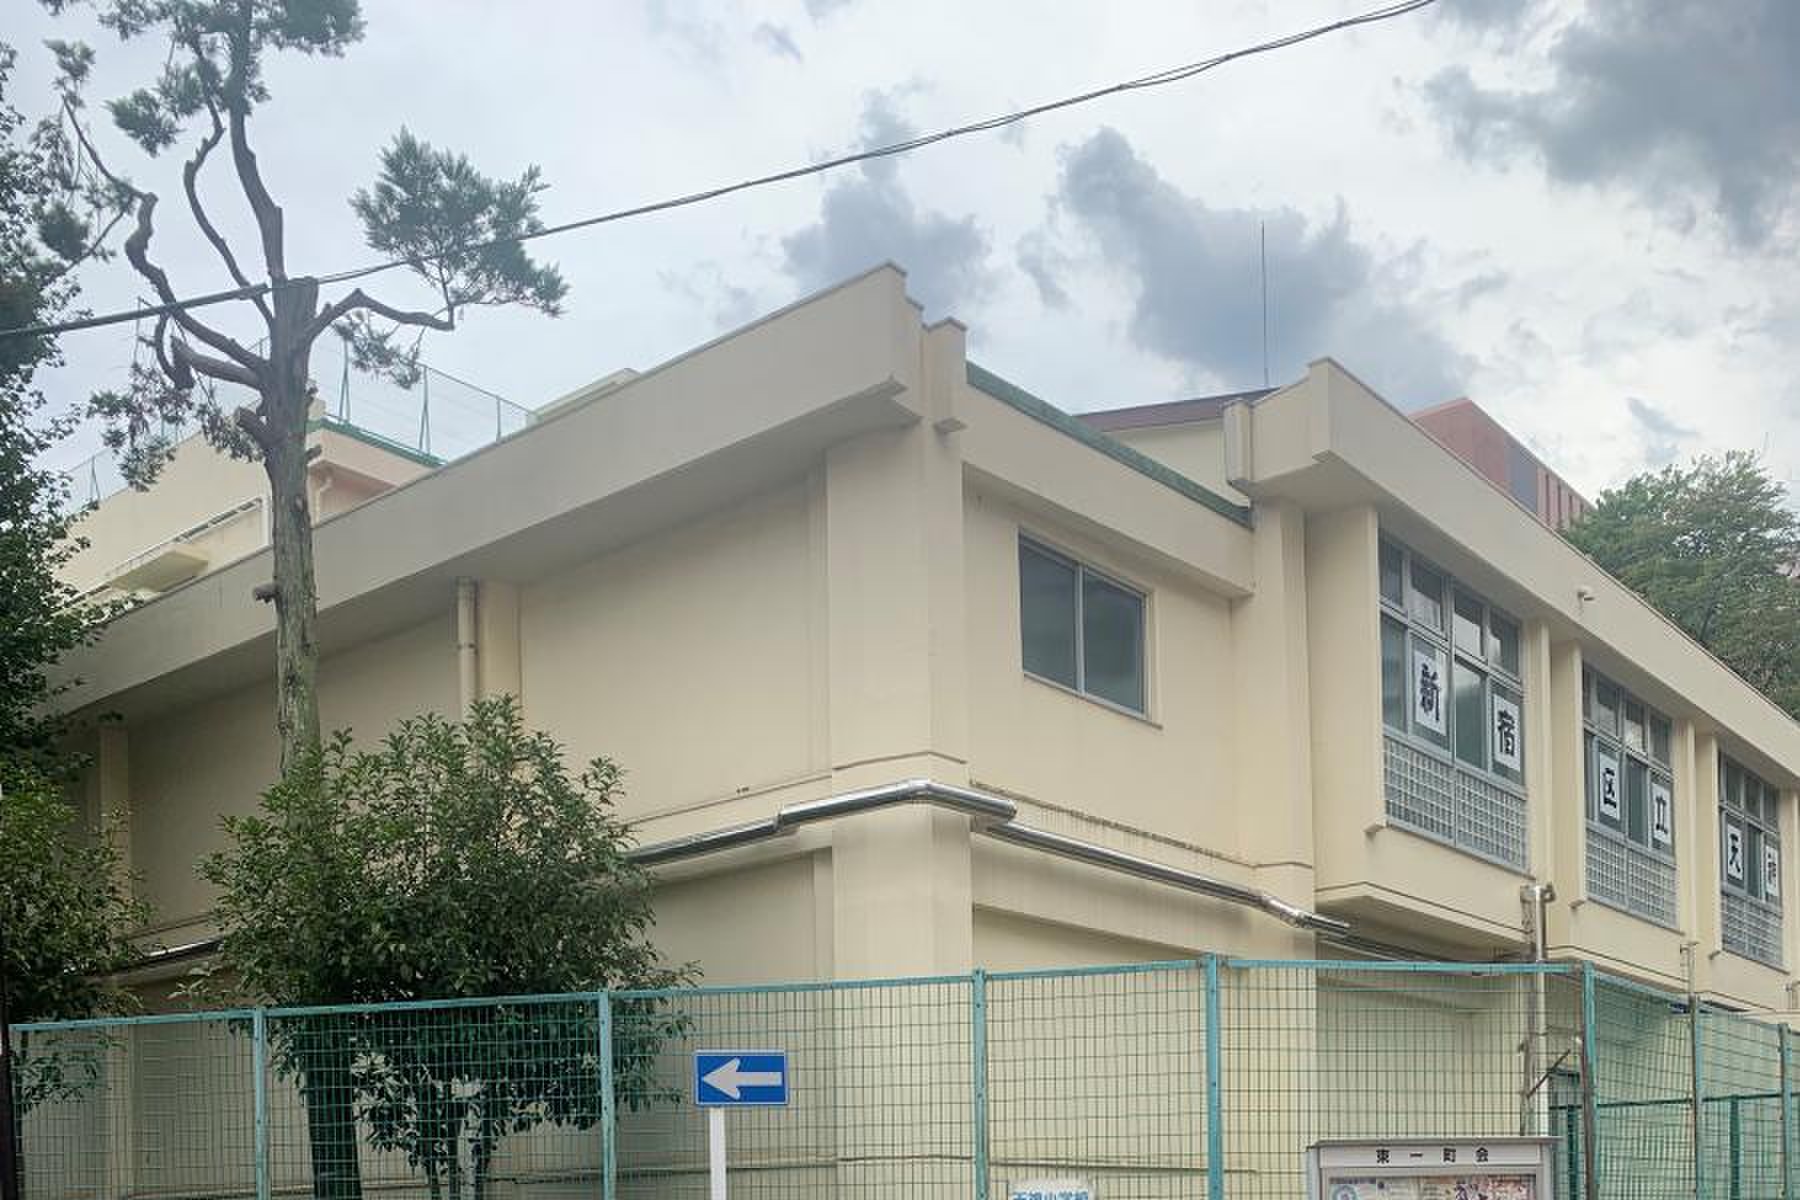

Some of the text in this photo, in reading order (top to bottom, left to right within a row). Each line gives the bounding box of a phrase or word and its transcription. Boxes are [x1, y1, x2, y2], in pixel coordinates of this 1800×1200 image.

[1421, 663, 1439, 722] 新
[1498, 710, 1514, 756] 宿
[1376, 1147, 1489, 1164] 東一町会
